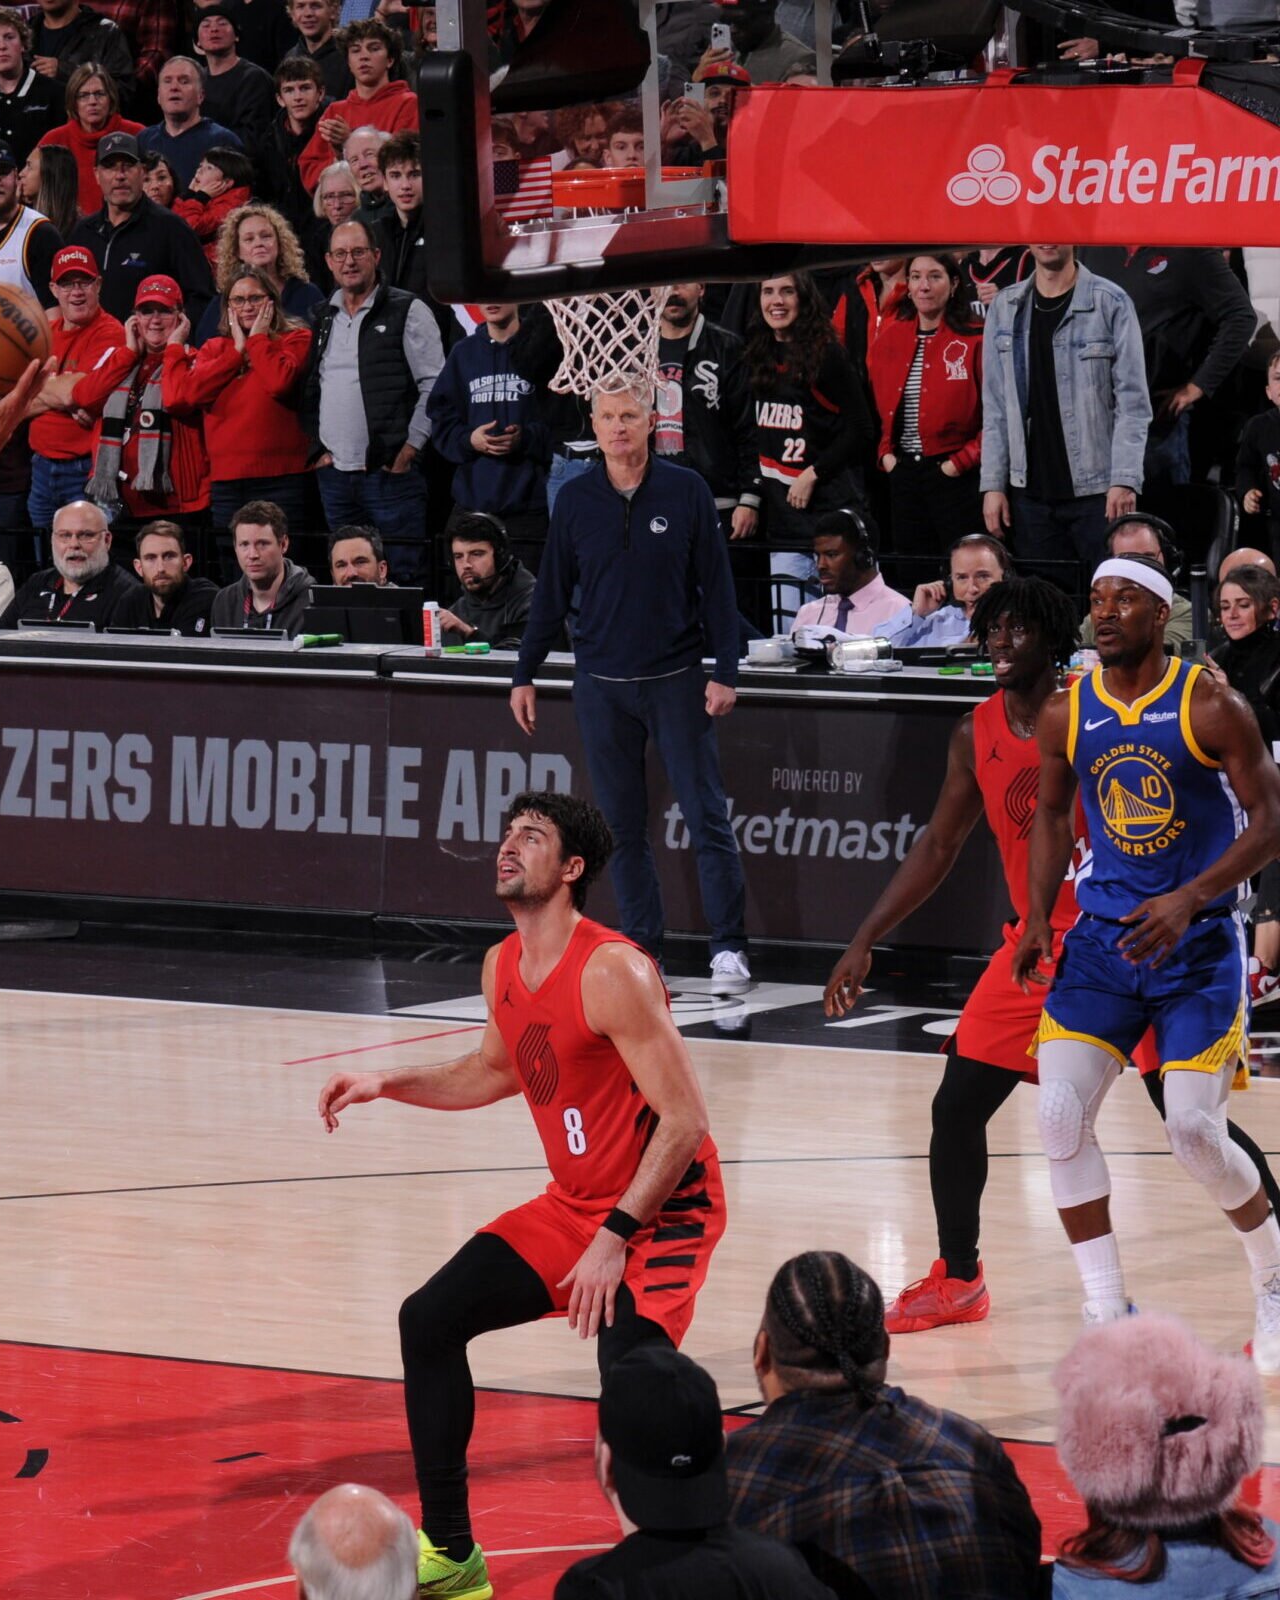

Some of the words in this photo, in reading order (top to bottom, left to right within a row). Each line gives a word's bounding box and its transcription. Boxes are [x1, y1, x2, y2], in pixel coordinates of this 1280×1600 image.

[782, 438, 806, 462] 22
[1143, 711, 1178, 723] Rakuten
[1090, 744, 1135, 775] GOLDEN
[1138, 744, 1173, 771] STATE
[169, 735, 423, 838] MOBILE
[772, 767, 840, 792] POWERED
[844, 772, 863, 794] BY
[1140, 775, 1162, 799] 10
[1103, 818, 1187, 856] WARRIORS
[563, 1107, 587, 1155] 8
